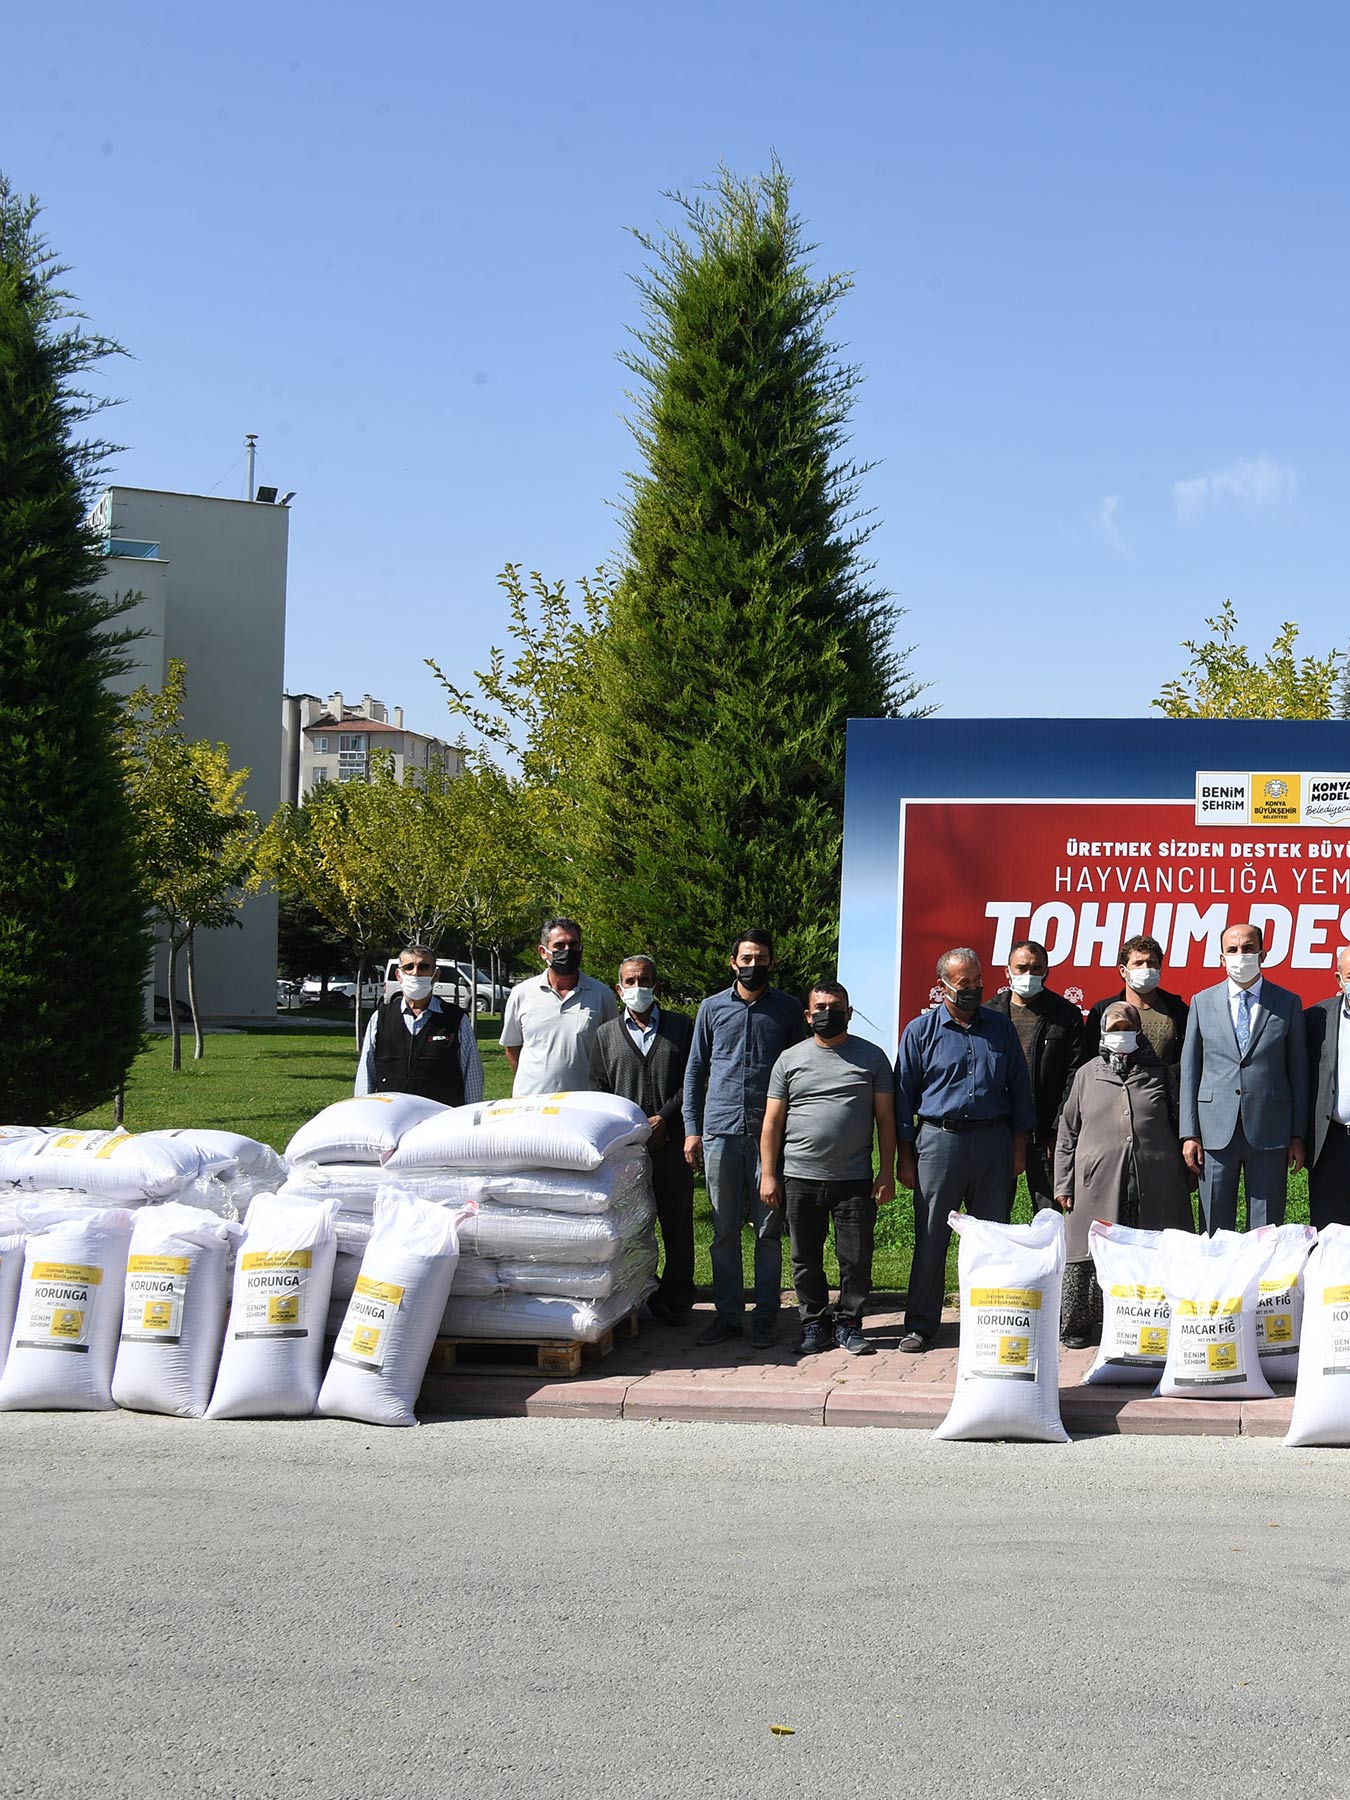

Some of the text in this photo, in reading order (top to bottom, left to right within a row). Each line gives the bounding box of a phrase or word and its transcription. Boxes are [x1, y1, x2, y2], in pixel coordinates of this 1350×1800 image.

[1066, 838, 1152, 857] ÜRETMEK
[1158, 839, 1224, 858] SİZDEN
[1230, 842, 1302, 858] DESTEK
[1055, 862, 1278, 894] HAYVANCILIĞA
[1291, 868, 1350, 894] YEM
[984, 901, 1230, 968] TOHUM
[131, 1280, 173, 1292] KORUNGA
[248, 1276, 300, 1287] KORUNGA
[35, 1288, 87, 1301] KORUNGA
[1116, 1306, 1150, 1317] MACAR
[978, 1315, 1030, 1327] KORUNGA
[1181, 1325, 1216, 1334] MACAR
